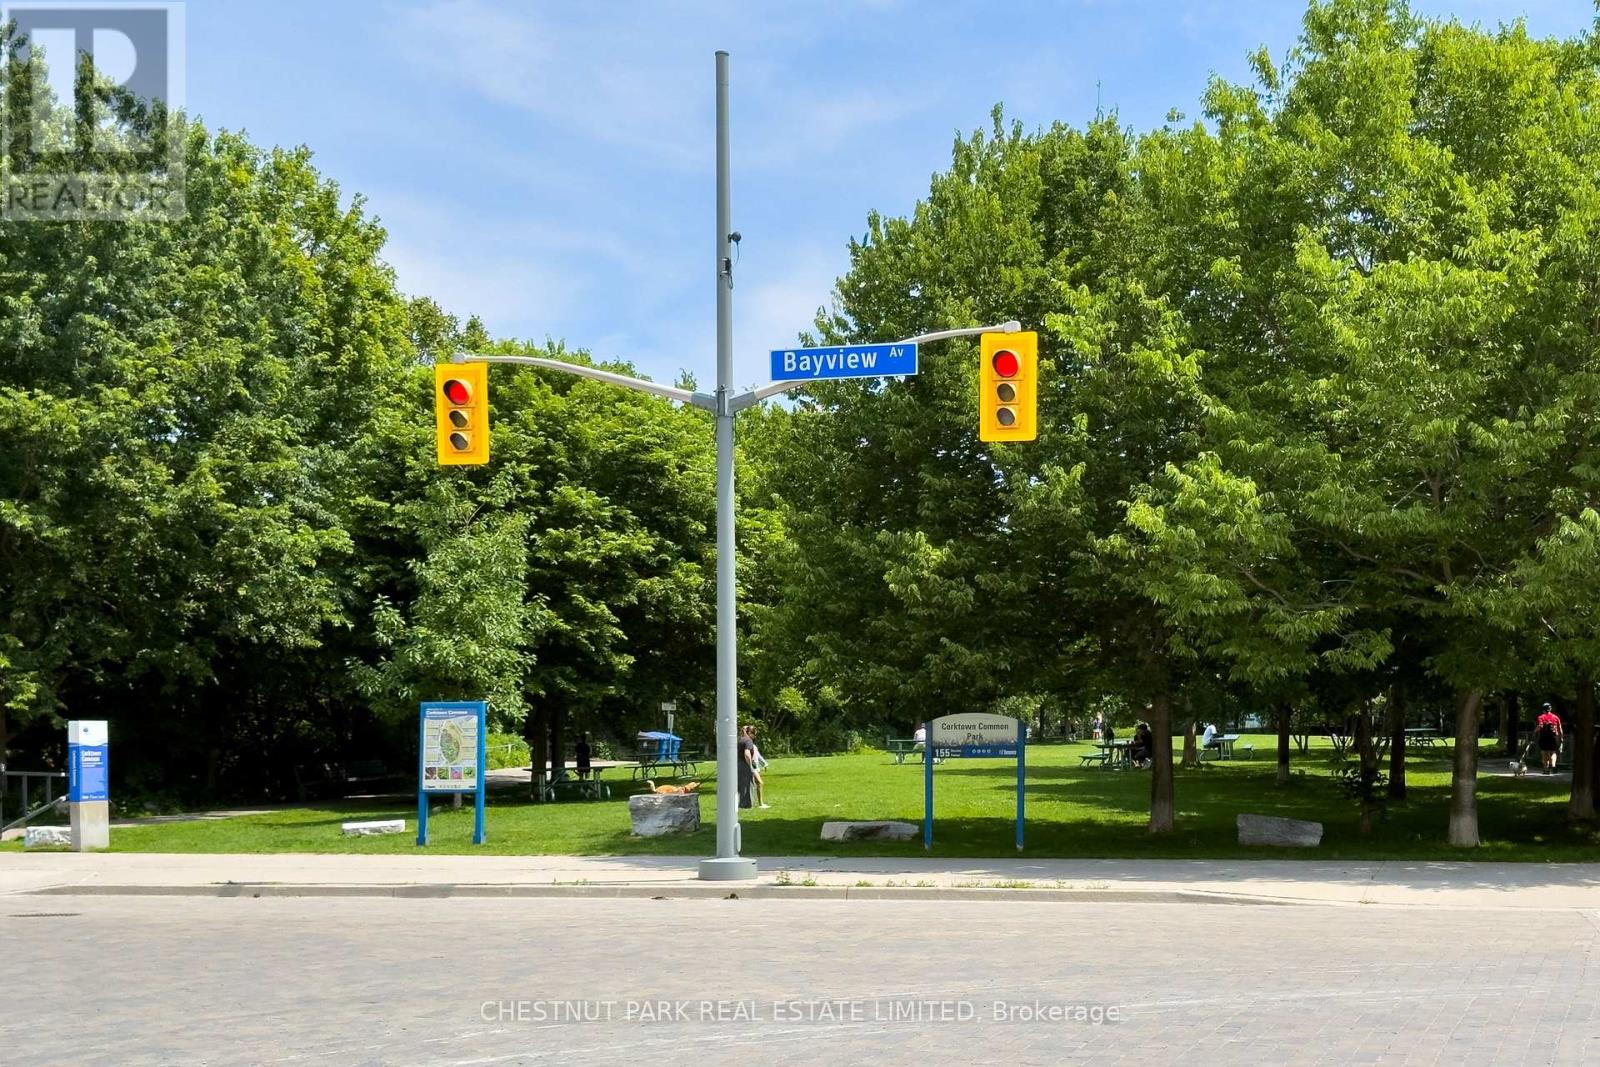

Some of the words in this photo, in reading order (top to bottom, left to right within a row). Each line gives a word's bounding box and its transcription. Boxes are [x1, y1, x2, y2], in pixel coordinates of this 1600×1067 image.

[784, 349, 877, 375] Bayview
[889, 346, 904, 358] Av
[941, 723, 976, 731] Corktown
